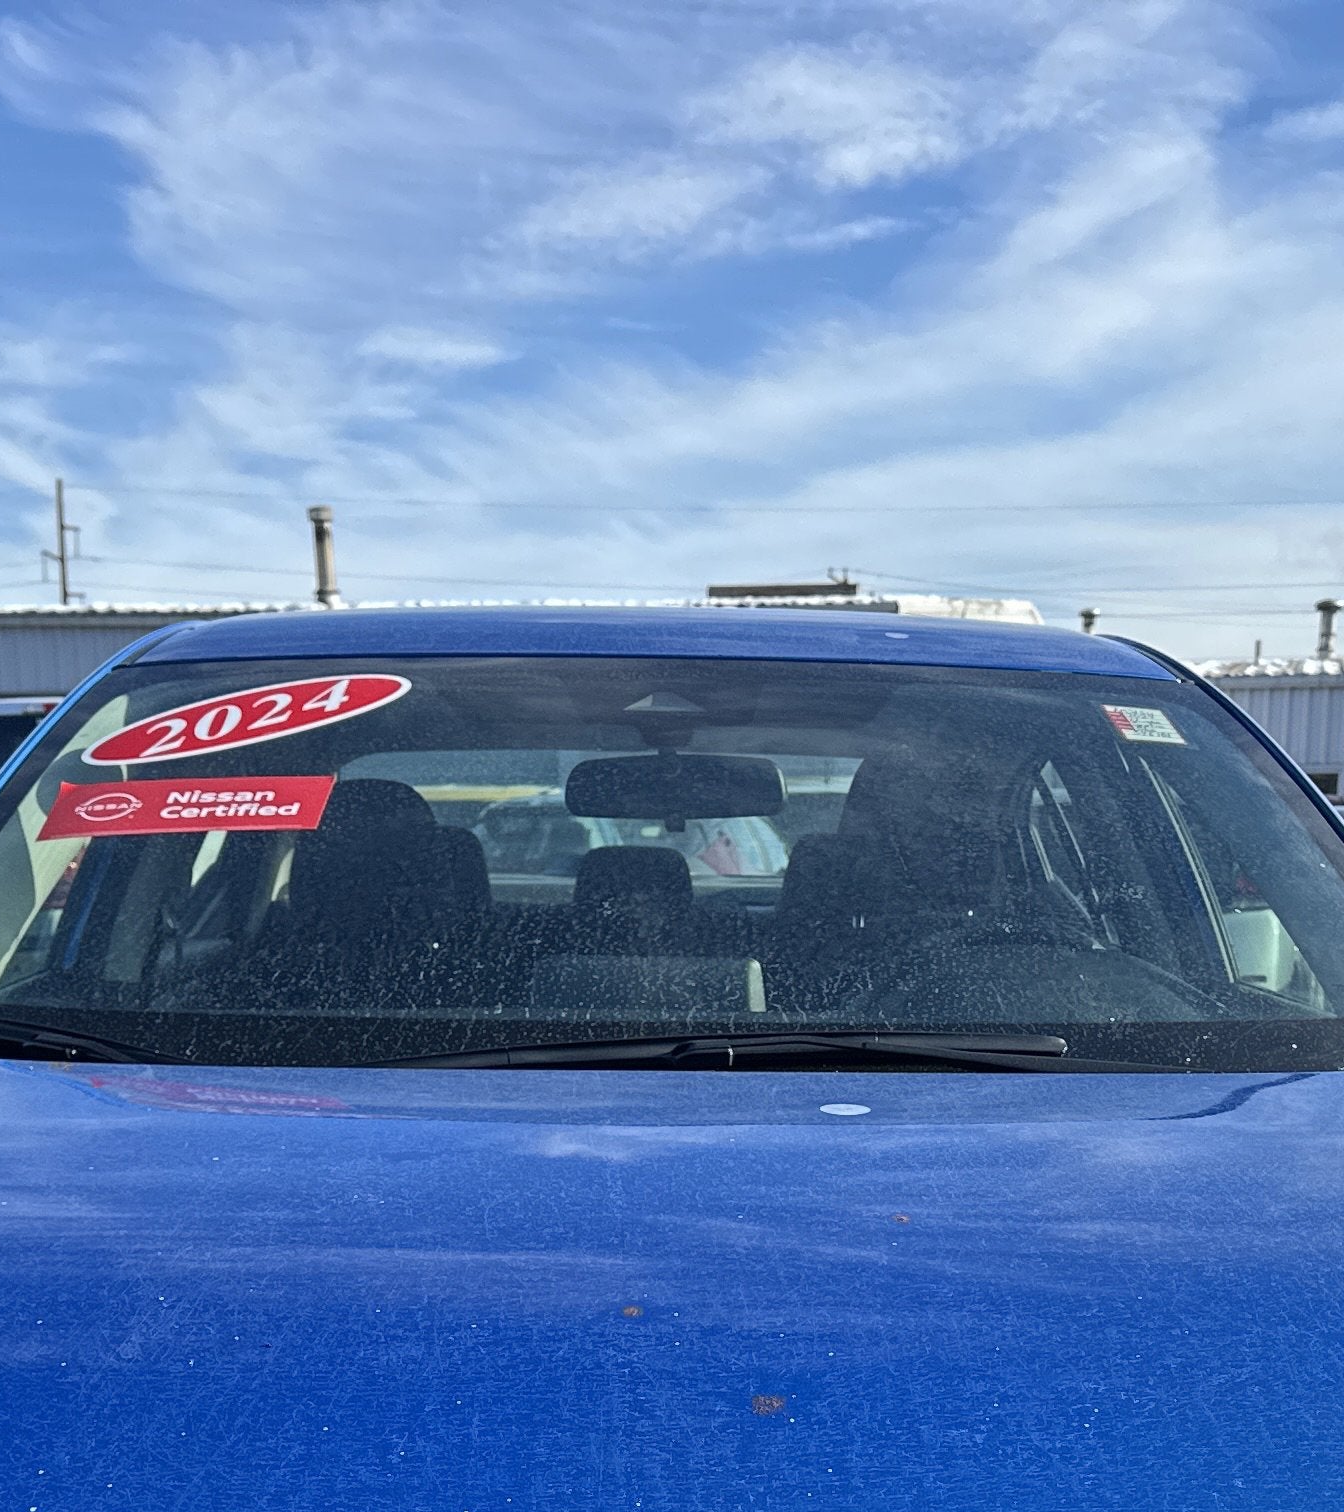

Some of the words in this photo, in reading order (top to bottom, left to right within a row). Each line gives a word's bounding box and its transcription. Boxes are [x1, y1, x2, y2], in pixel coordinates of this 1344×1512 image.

[139, 679, 351, 757] 2024
[165, 788, 276, 804] Nissan
[160, 801, 301, 819] Certified
